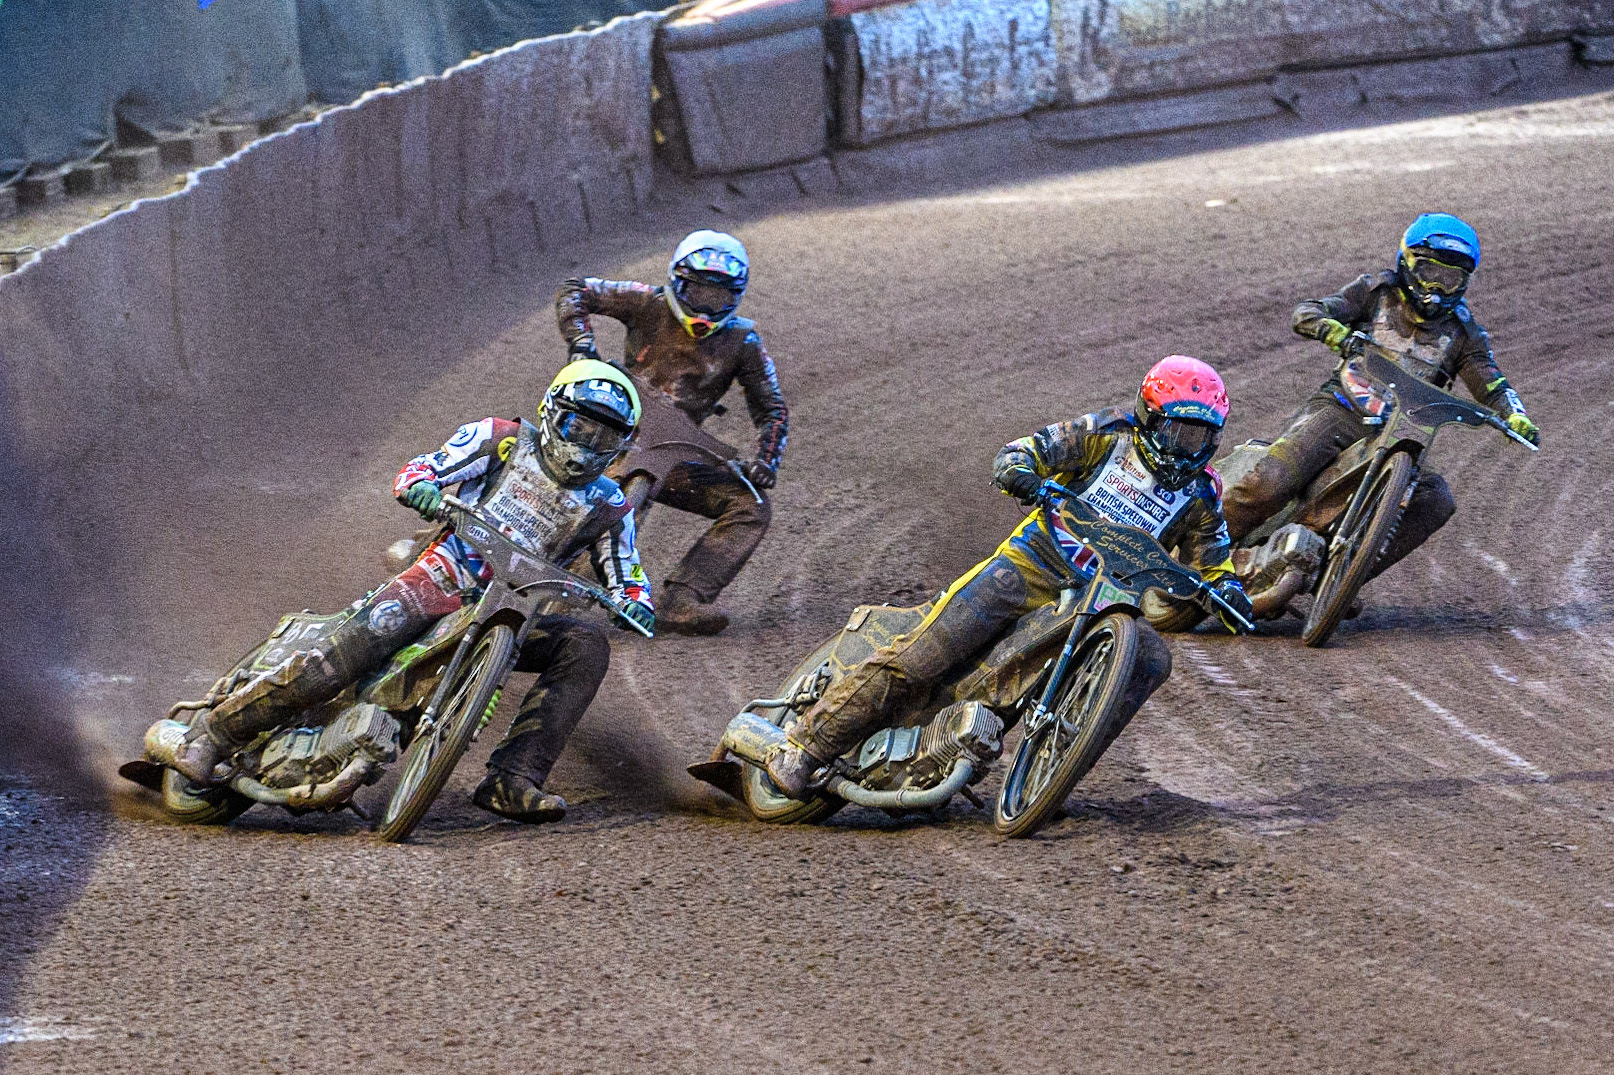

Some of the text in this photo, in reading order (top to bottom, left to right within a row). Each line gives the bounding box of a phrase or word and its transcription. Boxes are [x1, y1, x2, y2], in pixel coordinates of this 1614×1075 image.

[498, 495, 525, 518] BRITISH
[510, 483, 541, 511] SPORTS
[1095, 487, 1158, 533] BRITISH SPEEDWAY
[1106, 474, 1167, 522] SPORTS INSURE
[1158, 487, 1173, 501] SCB
[1090, 521, 1168, 568] Complete Car
[1096, 534, 1149, 571] Services
